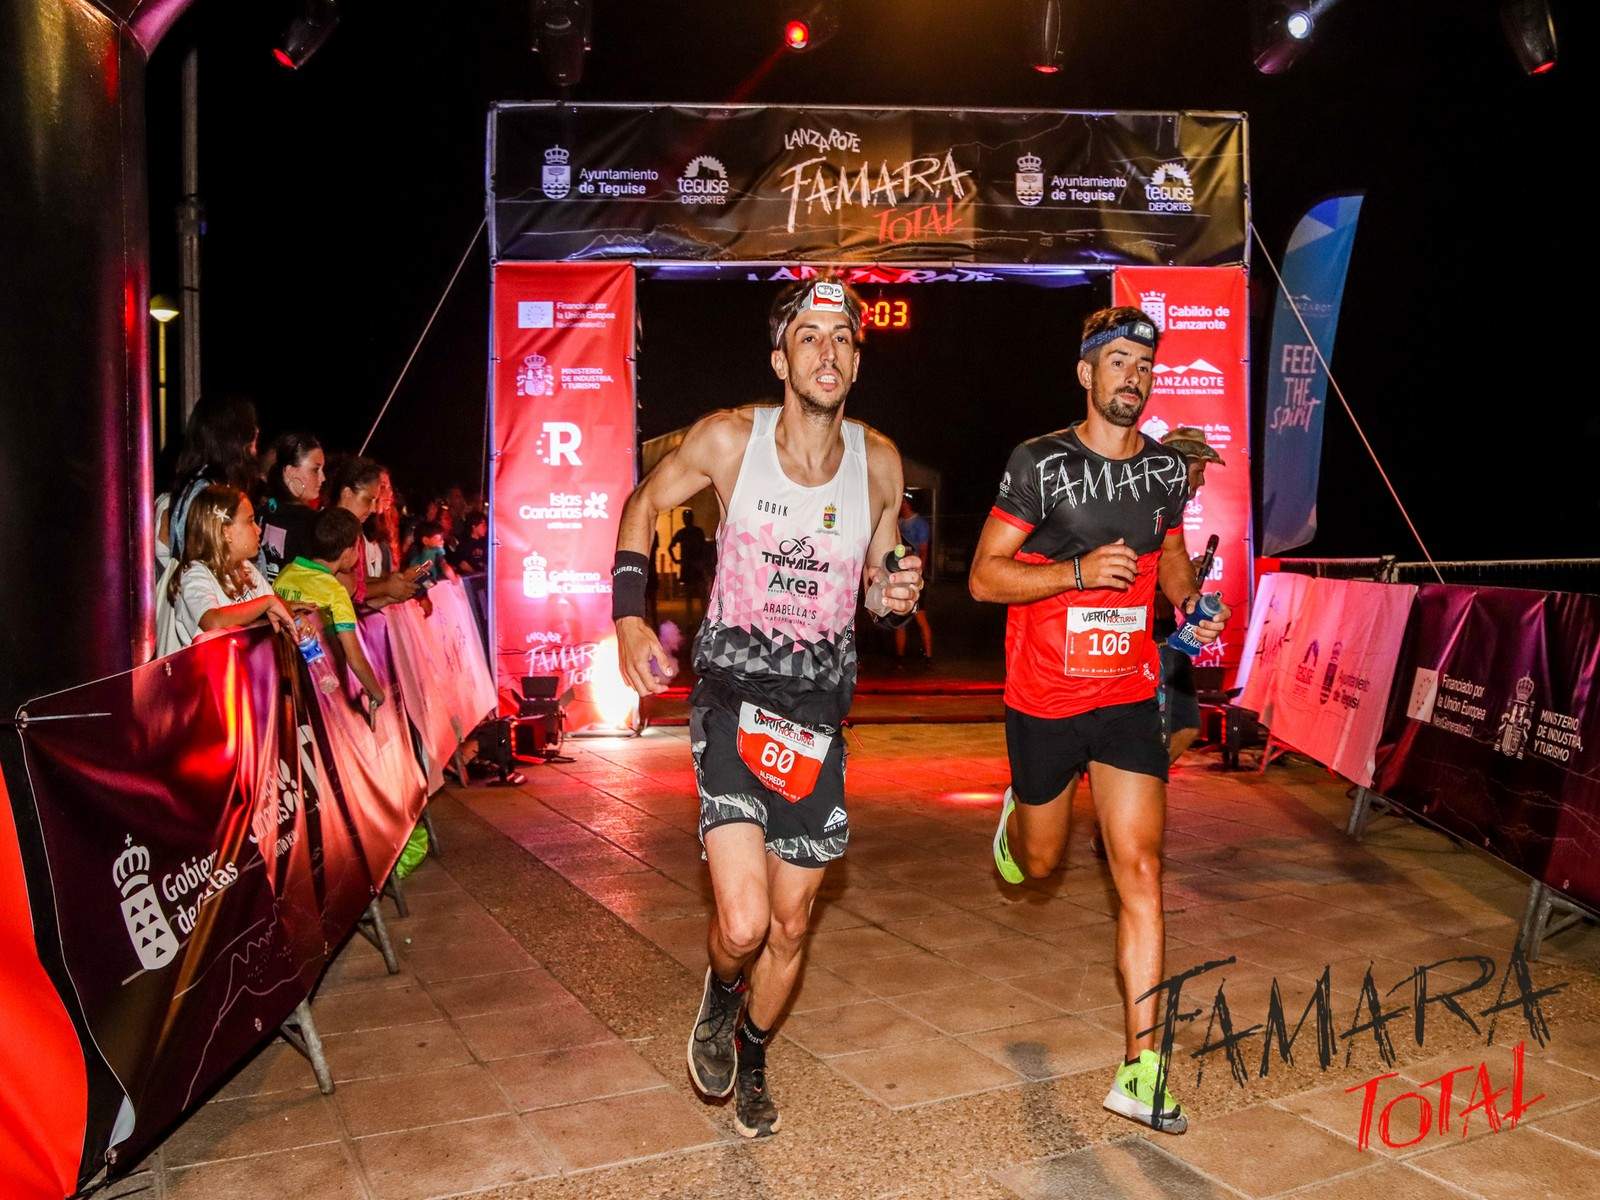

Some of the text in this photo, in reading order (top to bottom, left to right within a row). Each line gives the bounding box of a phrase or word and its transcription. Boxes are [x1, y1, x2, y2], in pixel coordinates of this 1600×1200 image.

[784, 128, 861, 153] LANZAROTE
[579, 168, 659, 183] Ayuntamiento
[1051, 175, 1127, 190] Ayuntamiento
[579, 182, 646, 198] de Teguise
[780, 148, 973, 234] FAMARA
[1051, 189, 1116, 203] de Teguise
[681, 195, 726, 206] DEPORTES
[1149, 201, 1192, 212] DEPORTES
[872, 196, 963, 245] TOTAL
[1168, 305, 1230, 317] Cabildo de
[1168, 319, 1227, 330] Lanzarote
[1281, 344, 1317, 374] FEEL
[1284, 377, 1312, 407] THE
[1036, 452, 1188, 520] FAMARA
[550, 492, 582, 509] Islas
[757, 499, 789, 517] GOBIK
[519, 505, 583, 519] Canarias
[613, 565, 643, 576] LURBEL
[769, 571, 818, 596] Area
[763, 602, 817, 620] ARABELLA'S
[1082, 608, 1120, 623] VERTICAL
[1105, 615, 1137, 624] NOCTURNA
[1088, 632, 1131, 656] 106
[526, 643, 600, 677] FAMAR
[1442, 674, 1485, 700] Financiado por
[1438, 695, 1487, 721] la Unión Europea
[1540, 709, 1580, 731] MINISTERIO
[1536, 724, 1548, 737] DE
[761, 742, 796, 773] 60
[1534, 739, 1571, 762] Y TURISMO
[760, 770, 786, 788] ALFREDO
[162, 849, 219, 902] Gobier
[177, 904, 198, 935] de
